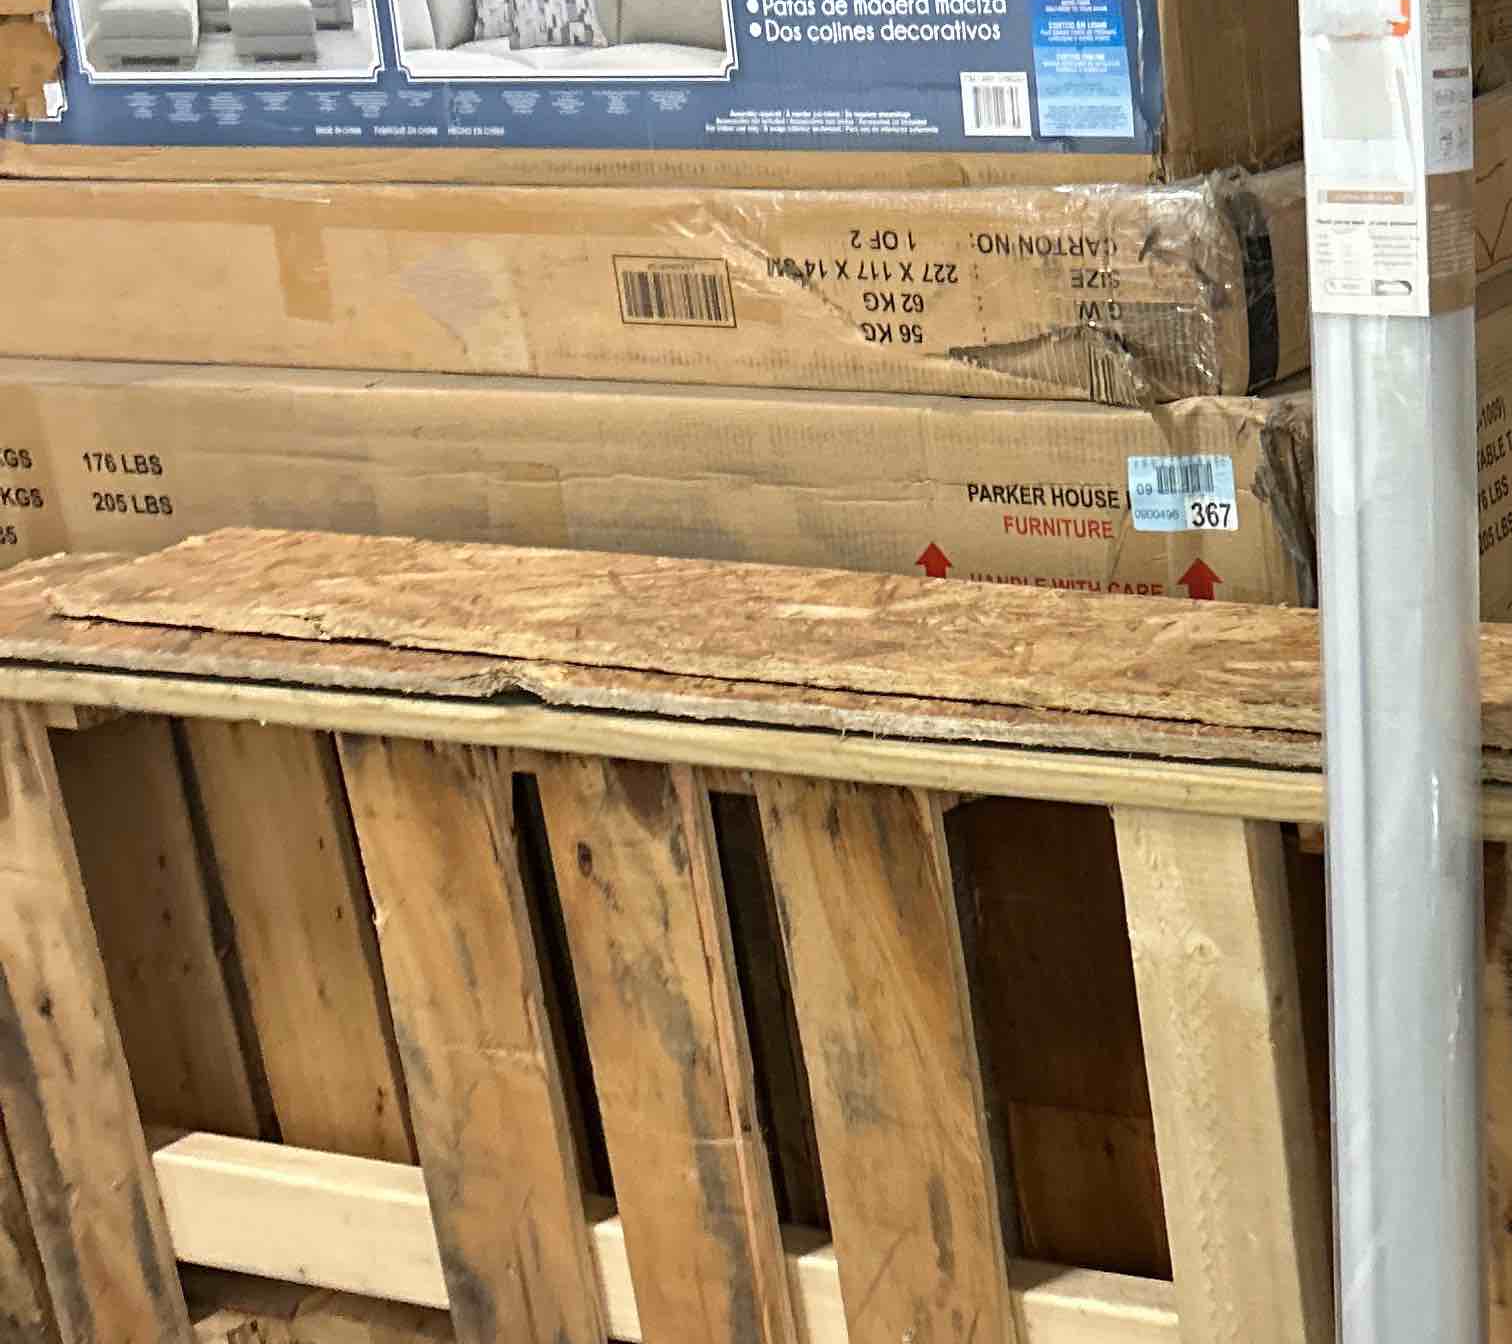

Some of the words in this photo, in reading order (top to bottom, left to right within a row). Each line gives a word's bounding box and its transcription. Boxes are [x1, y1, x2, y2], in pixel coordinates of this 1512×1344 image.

[764, 20, 803, 43] Dos
[806, 18, 876, 45] cojines
[880, 18, 1001, 42] decorativos
[851, 229, 863, 249] 2
[870, 230, 898, 250] OF
[908, 229, 917, 251] 1
[836, 259, 849, 279] X
[857, 260, 892, 280] 117
[900, 262, 914, 282] X
[922, 263, 959, 283] 227
[863, 292, 896, 312] KG
[901, 294, 924, 313] 62
[861, 323, 893, 343] KG
[899, 325, 923, 344] 56
[82, 452, 117, 473] 176
[121, 454, 163, 475] LBS
[968, 484, 1046, 506] PARKER
[1052, 489, 1121, 510] HOUSE
[1136, 483, 1154, 496] 09
[1489, 473, 1511, 504] LBS
[0, 487, 43, 508] KGS
[92, 492, 128, 513] 205
[131, 495, 174, 516] LBS
[1190, 501, 1231, 528] 367
[1003, 514, 1115, 539] FURNITURE
